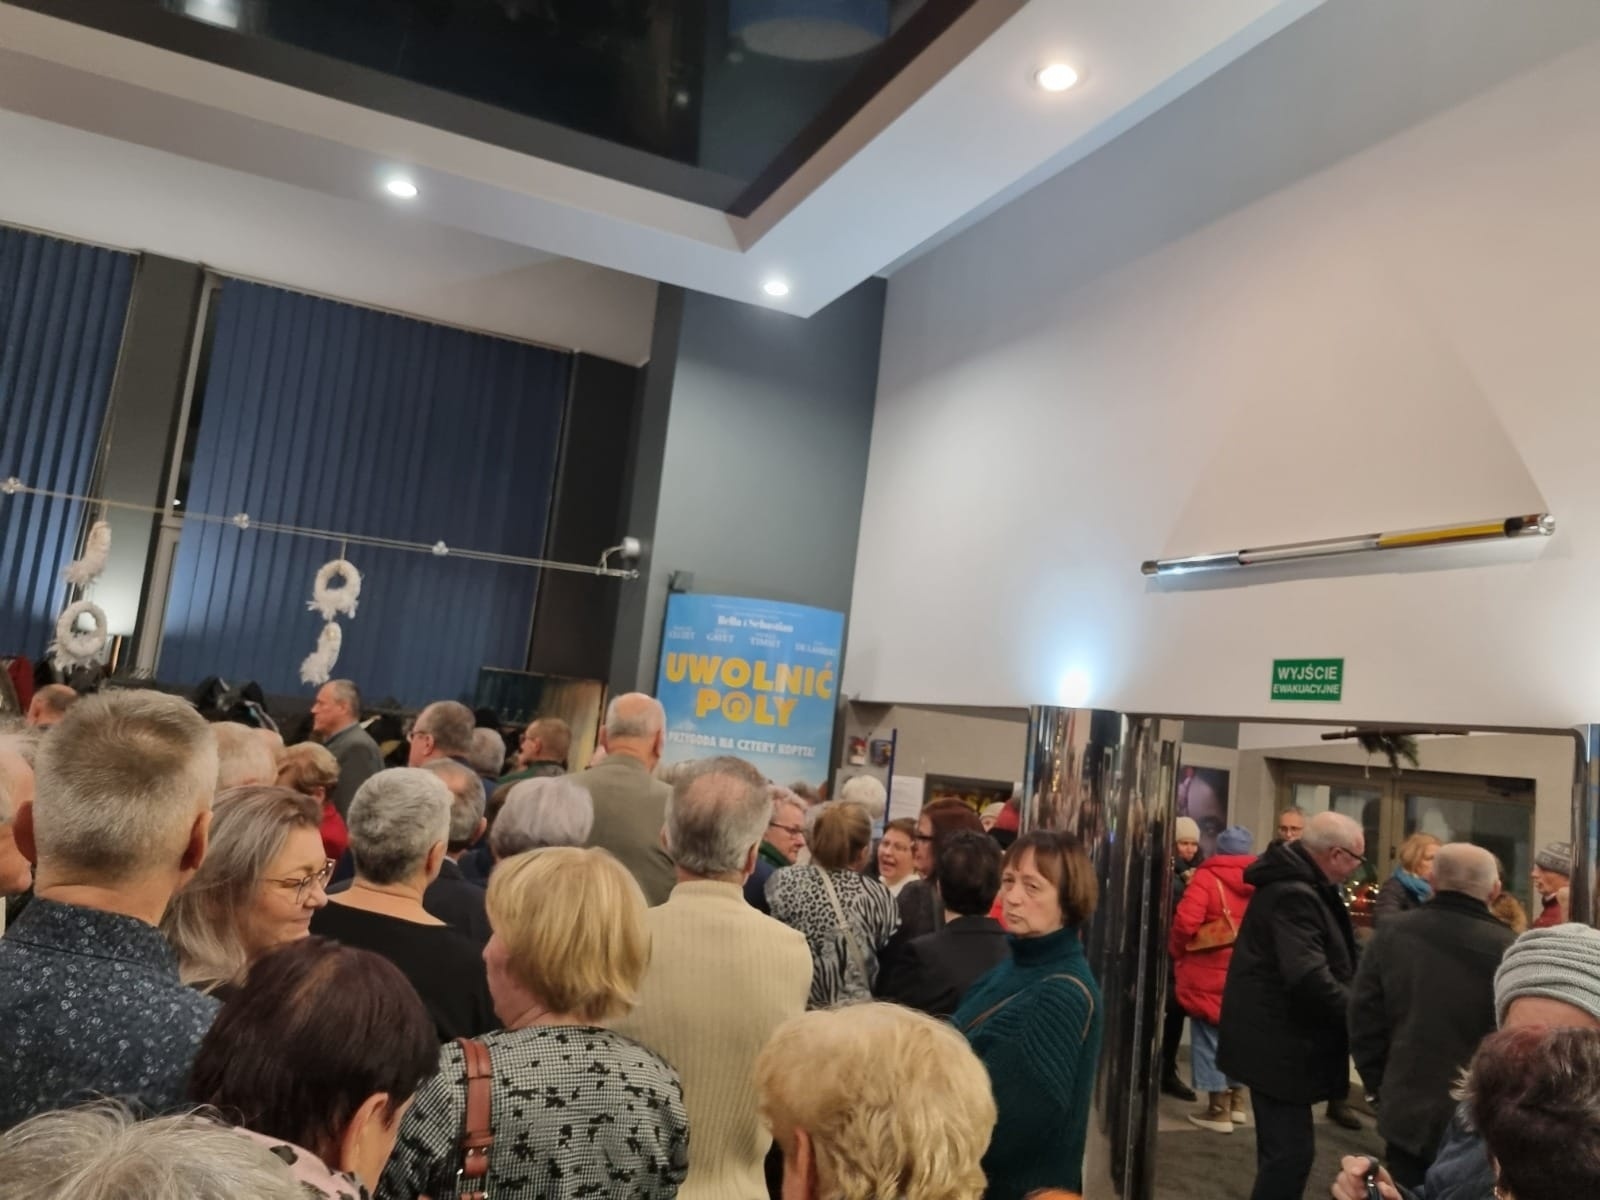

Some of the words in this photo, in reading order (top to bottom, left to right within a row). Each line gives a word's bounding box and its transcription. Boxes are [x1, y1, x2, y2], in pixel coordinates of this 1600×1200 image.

[665, 652, 833, 699] UWOLNIĆ
[1277, 663, 1338, 680] WYJŚCIE
[1272, 683, 1340, 694] EWAKUACYJNE
[695, 688, 798, 727] POLY
[719, 737, 734, 750] NA
[737, 738, 776, 753] CZTERY
